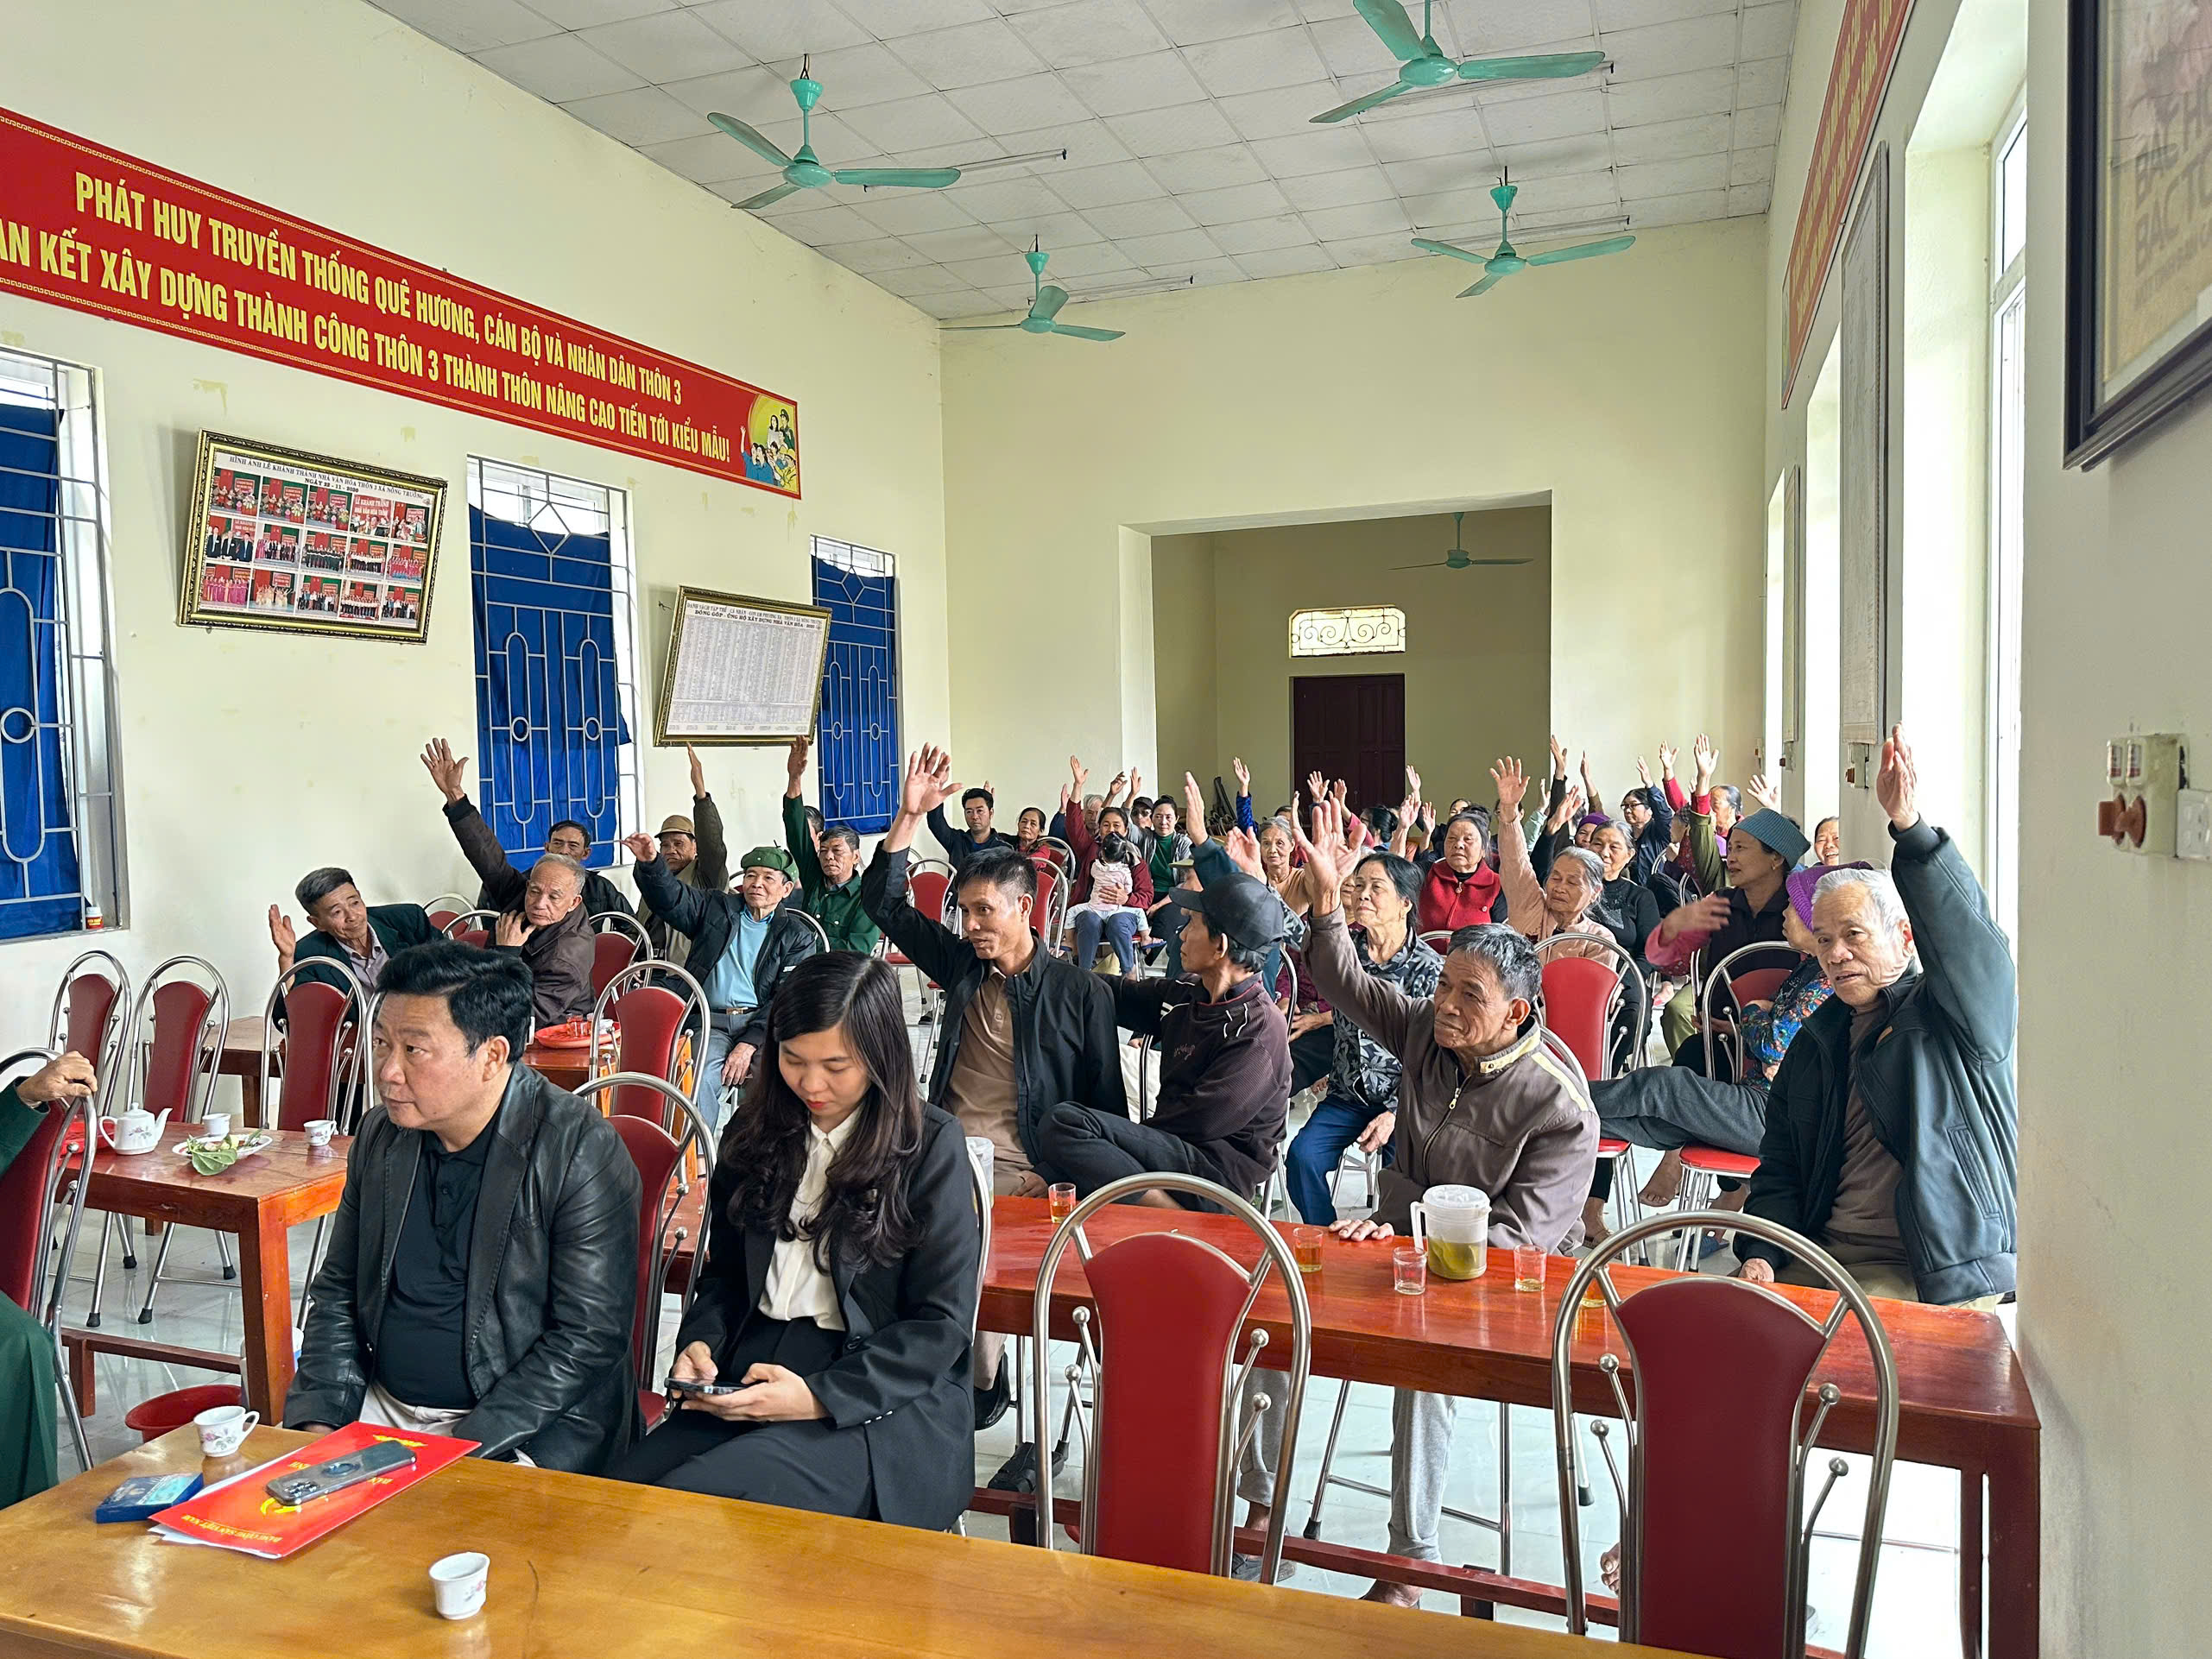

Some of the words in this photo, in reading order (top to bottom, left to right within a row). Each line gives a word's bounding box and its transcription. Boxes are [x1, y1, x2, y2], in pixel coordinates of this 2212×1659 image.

[40, 228, 92, 283] KẾT
[100, 248, 152, 300] XÂY
[161, 268, 227, 322] DỰNG
[234, 290, 307, 344] THÀNH
[314, 312, 369, 362] CÔNG
[375, 332, 422, 376] THÔN
[428, 350, 439, 381] 3
[443, 354, 497, 398] THÀNH
[502, 371, 541, 410] THÔN
[546, 382, 586, 422] NÂNG
[590, 398, 616, 430] CAO
[619, 403, 648, 439] TIẾN
[650, 413, 668, 445] TỚI
[673, 417, 698, 453] KIỂU
[701, 426, 730, 463] MẪU!
[75, 172, 145, 230] PHÁT
[154, 199, 201, 249] HUY
[209, 218, 295, 281] TRUYỀN
[302, 250, 369, 304] THỐNG
[376, 277, 410, 318] QUÊ
[416, 290, 479, 344] HƯƠNG,
[484, 312, 516, 352] CÁN
[521, 325, 540, 366] BỘ
[545, 332, 564, 367] VÀ
[567, 343, 605, 381] NHÂN
[609, 355, 635, 390] DÂN
[639, 367, 671, 401] THÔN
[674, 380, 682, 406] 3
[229, 456, 247, 464] HÌNH
[272, 464, 294, 475] KHÁNH
